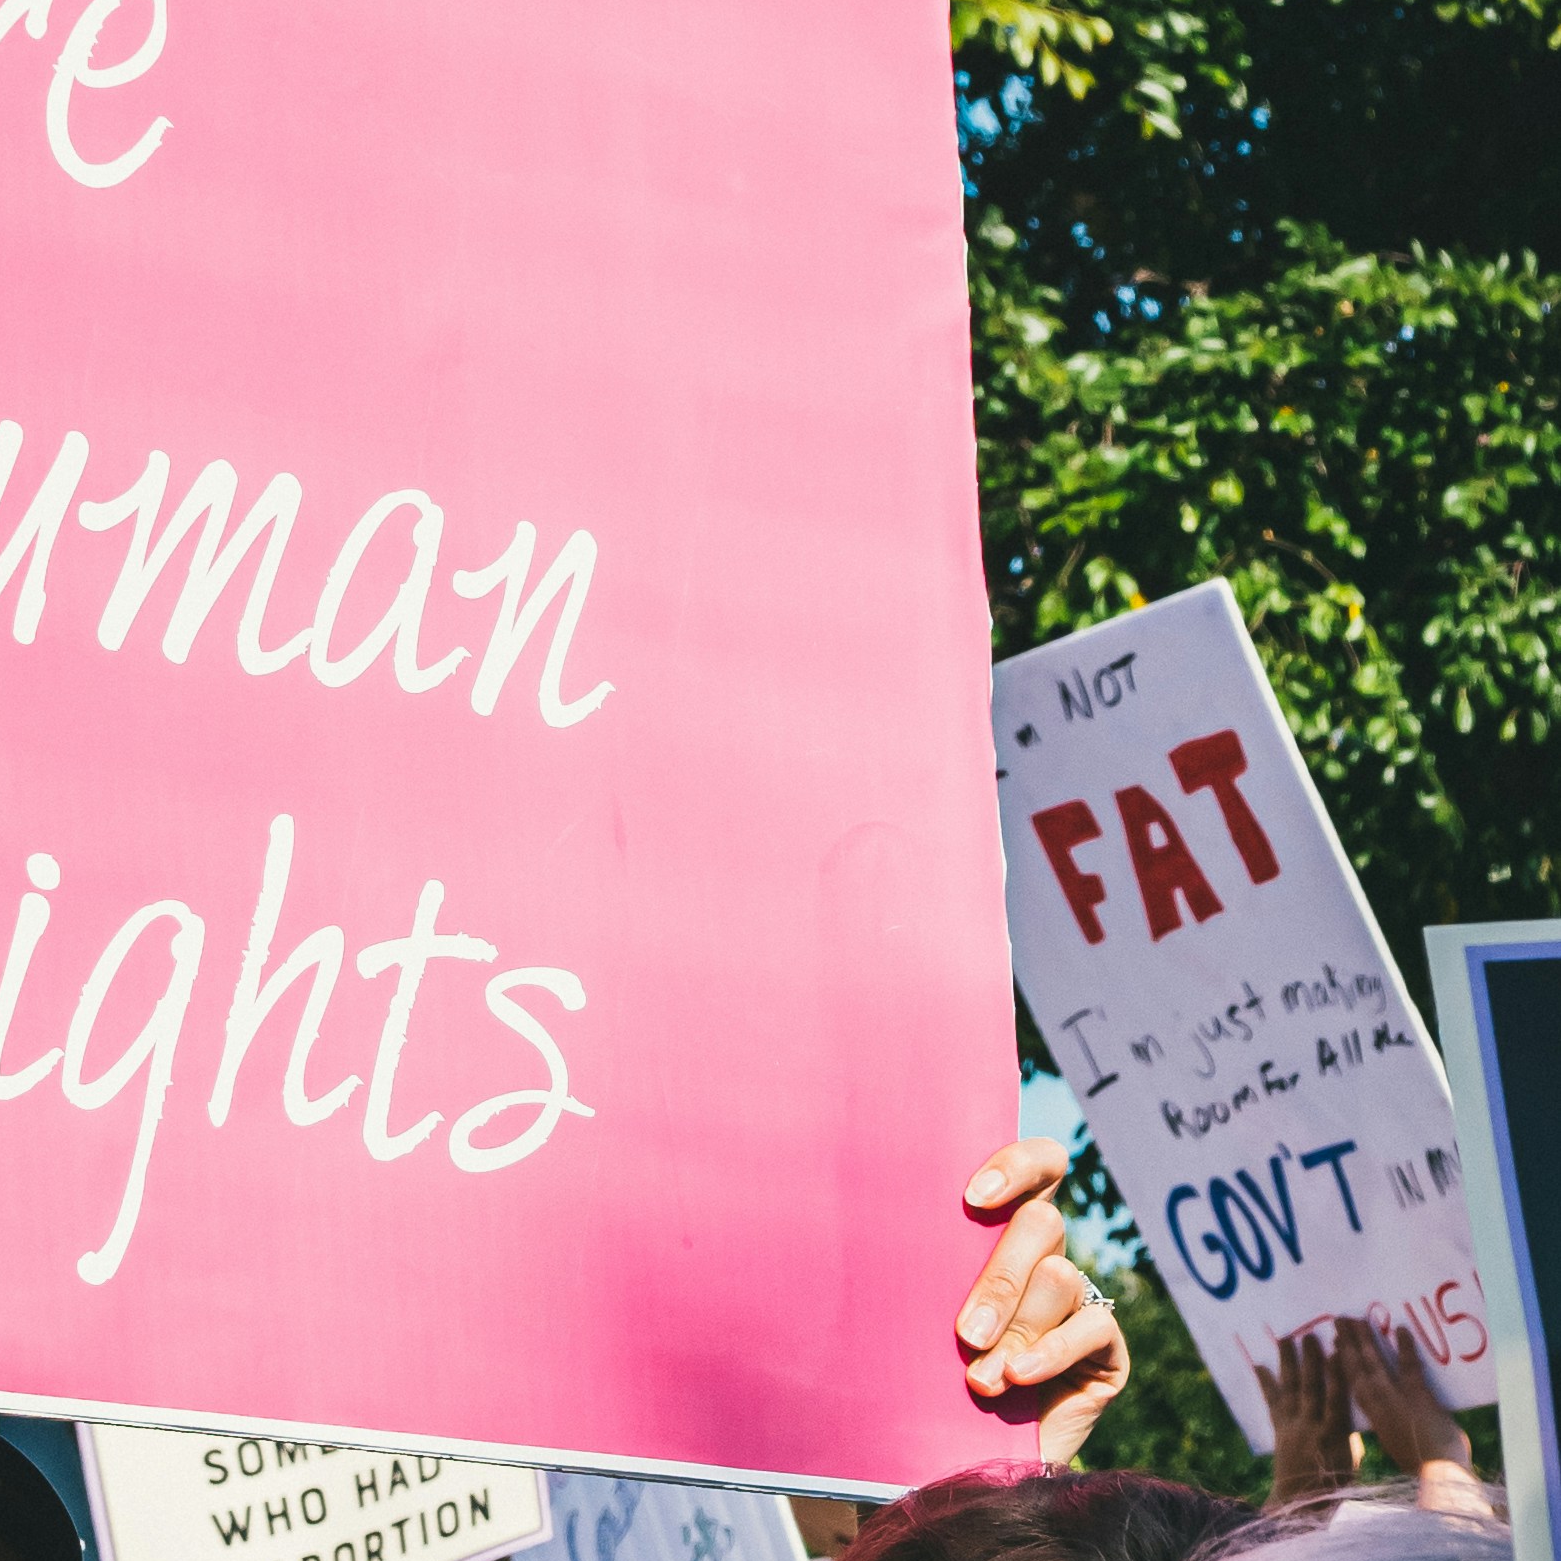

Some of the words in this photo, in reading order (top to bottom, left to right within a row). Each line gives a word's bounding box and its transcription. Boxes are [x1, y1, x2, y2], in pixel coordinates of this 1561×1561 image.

[1056, 651, 1137, 721] NOT
[1030, 728, 1281, 946] FAT
[1193, 980, 1267, 1079] just
[1316, 1028, 1364, 1077] All
[1165, 1138, 1364, 1301] GOV'T
[1386, 1159, 1426, 1210] IN
[203, 1440, 339, 1486] SOM
[211, 1487, 328, 1546] WHO
[354, 1455, 442, 1509] HAD
